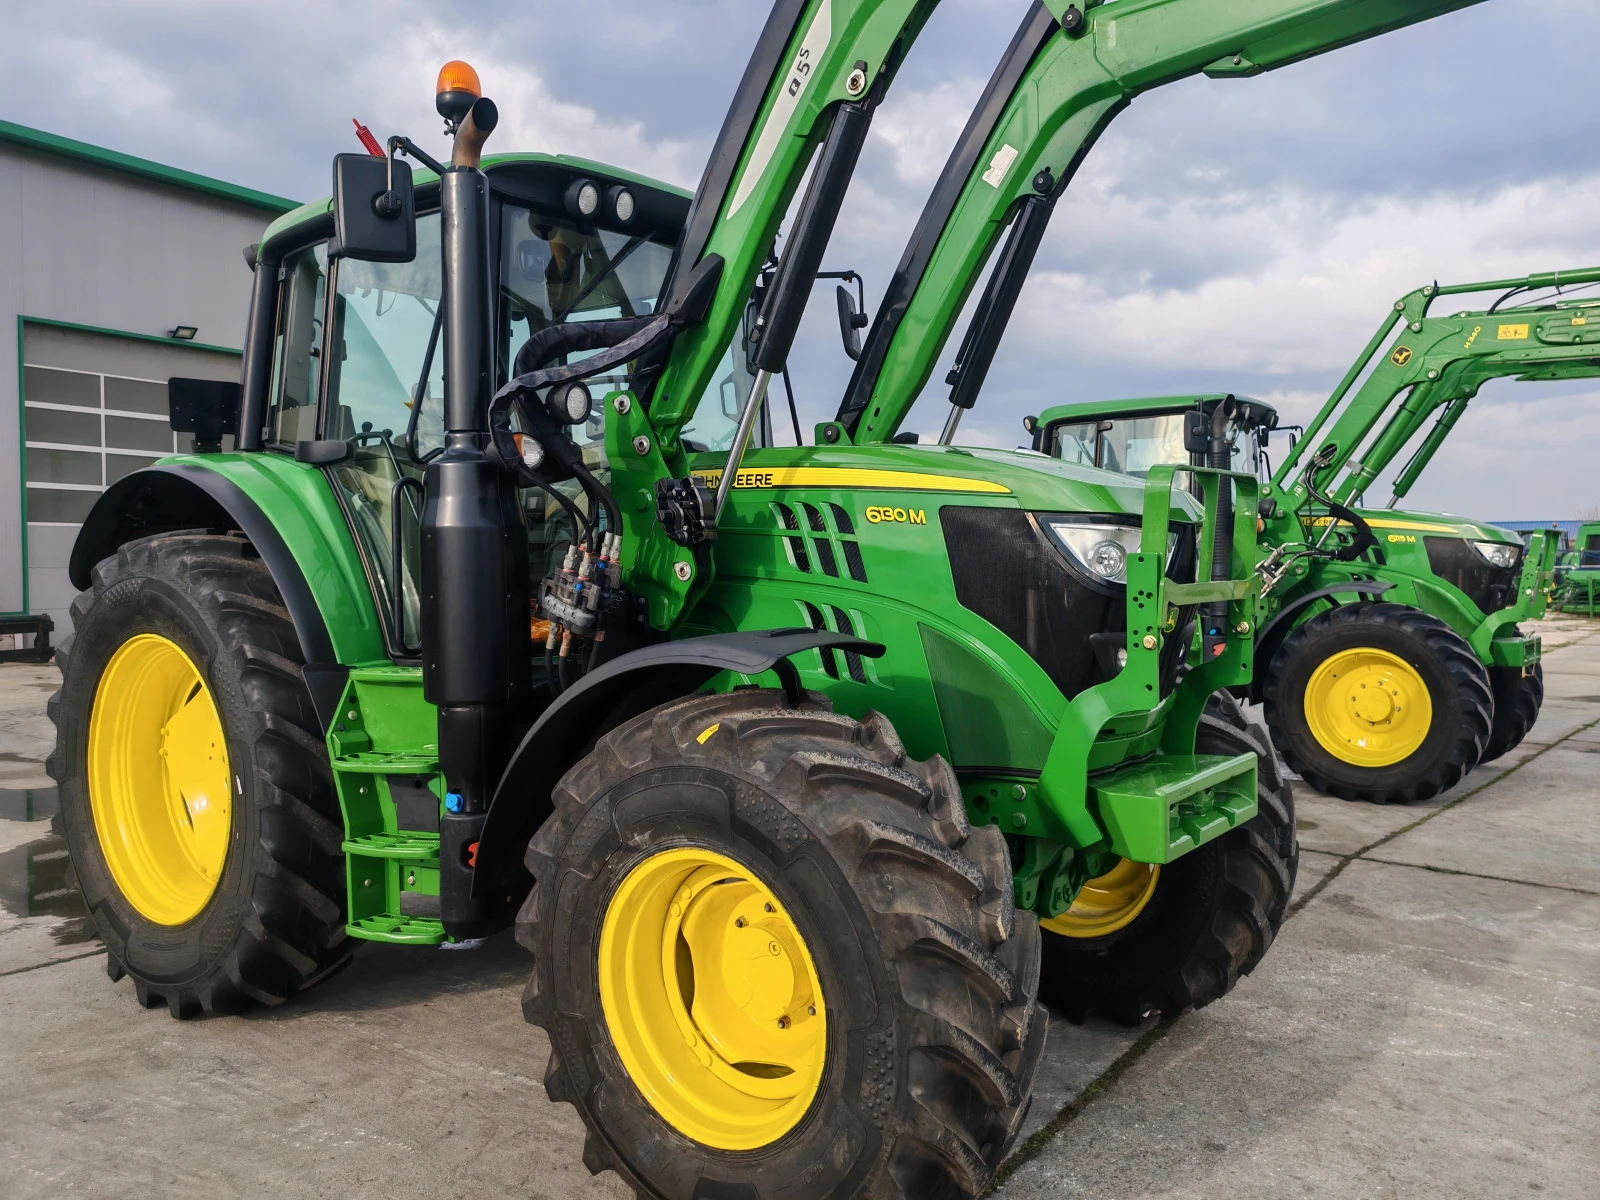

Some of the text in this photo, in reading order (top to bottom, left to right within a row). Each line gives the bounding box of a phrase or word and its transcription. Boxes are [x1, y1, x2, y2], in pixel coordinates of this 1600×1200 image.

[734, 473, 774, 487] EERE
[865, 505, 928, 525] 6130 M
